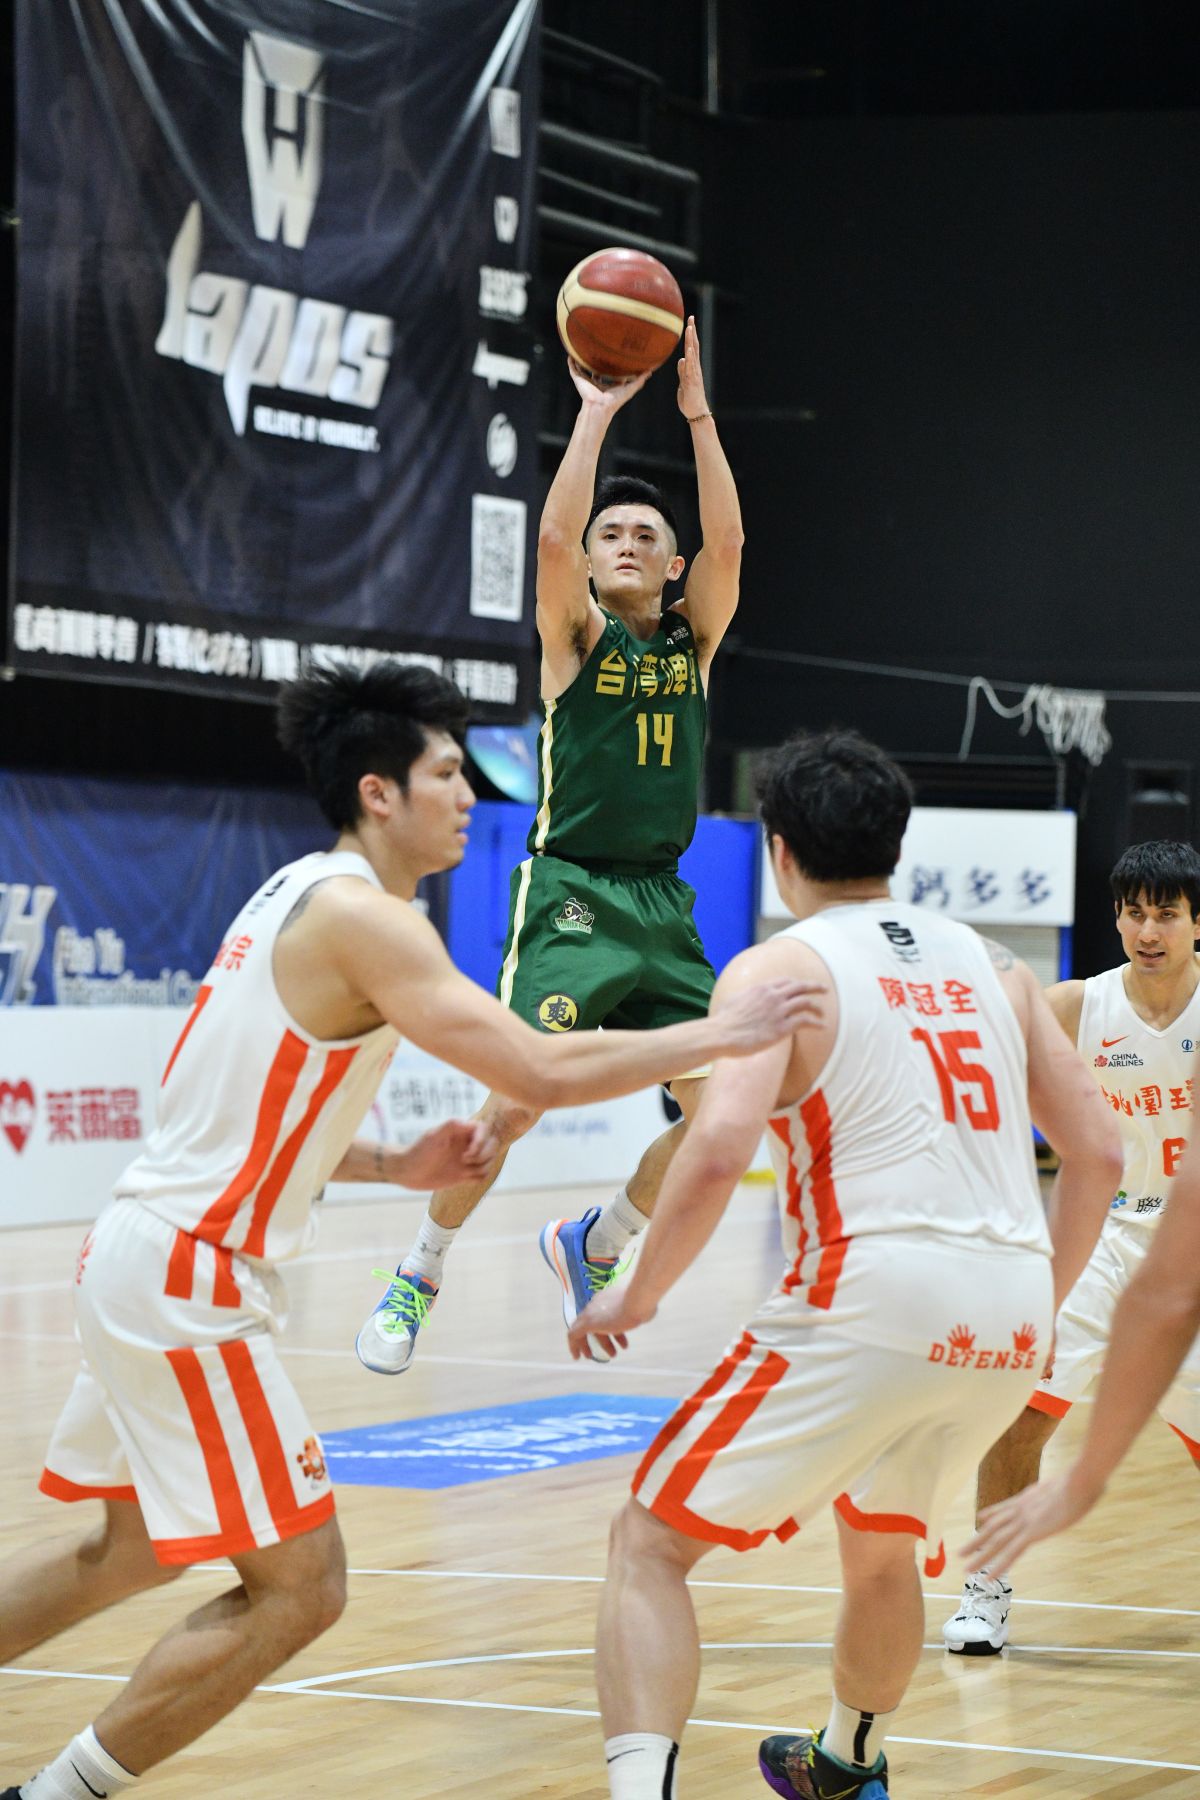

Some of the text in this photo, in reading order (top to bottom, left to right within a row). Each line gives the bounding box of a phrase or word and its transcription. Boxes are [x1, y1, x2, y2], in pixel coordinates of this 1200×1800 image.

[636, 713, 674, 767] 14
[1108, 1058, 1144, 1067] AIRLINES
[1111, 1053, 1139, 1061] CHINA
[911, 1027, 1000, 1132] 15
[928, 1342, 1037, 1370] DEFENSE
